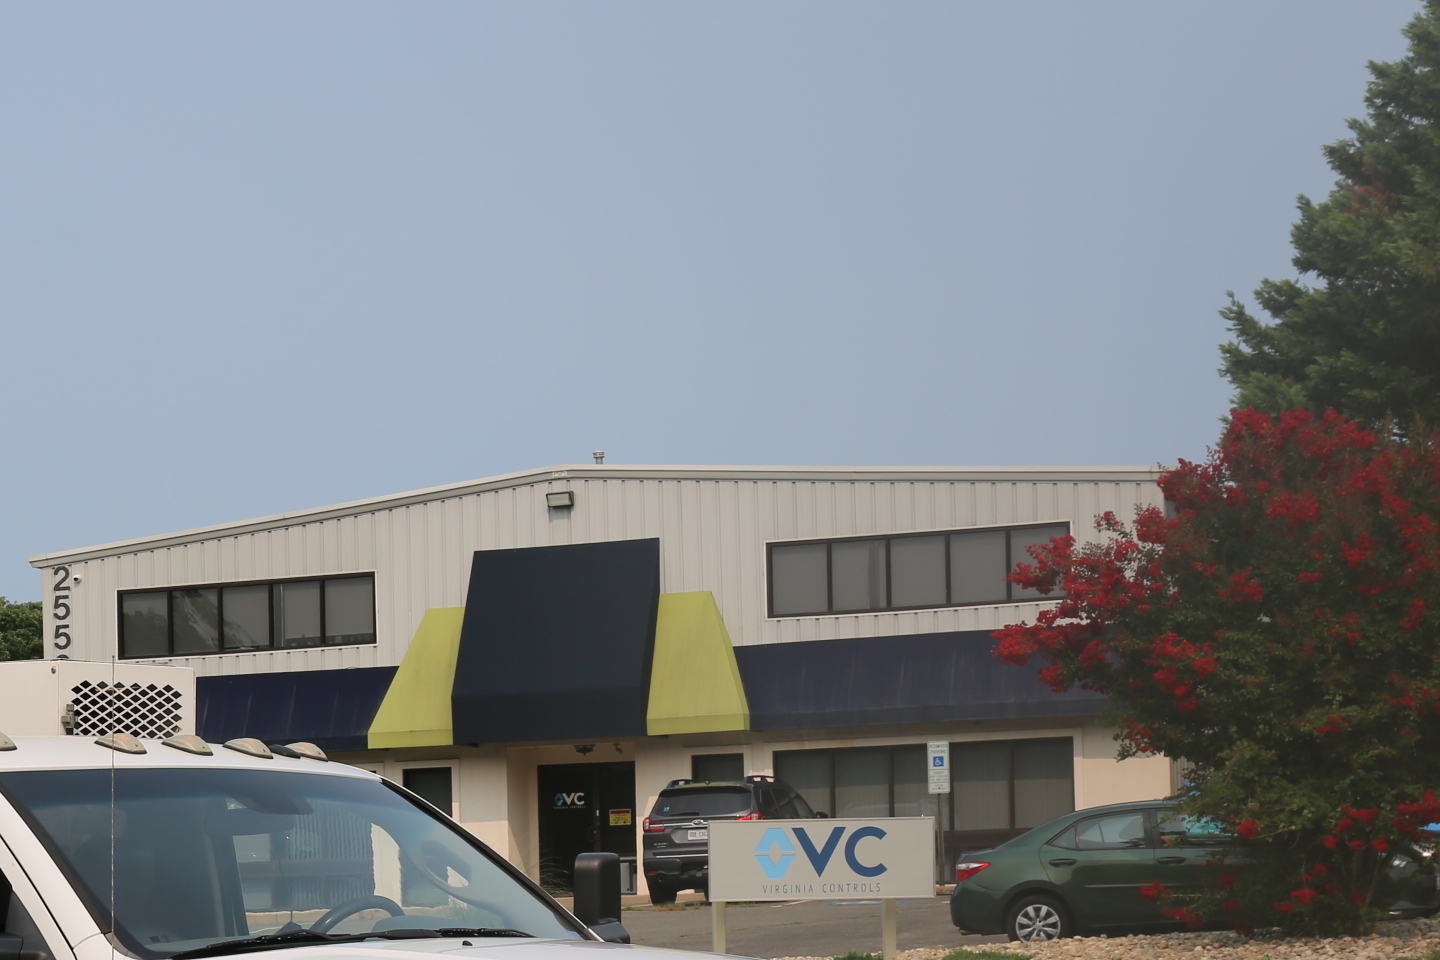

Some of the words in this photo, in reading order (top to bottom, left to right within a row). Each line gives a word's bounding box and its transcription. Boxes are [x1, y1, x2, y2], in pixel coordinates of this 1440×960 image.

[53, 565, 71, 660] 255
[791, 826, 888, 878] VC
[762, 884, 814, 894] VIRGINIA
[822, 882, 881, 893] CONTROLS
